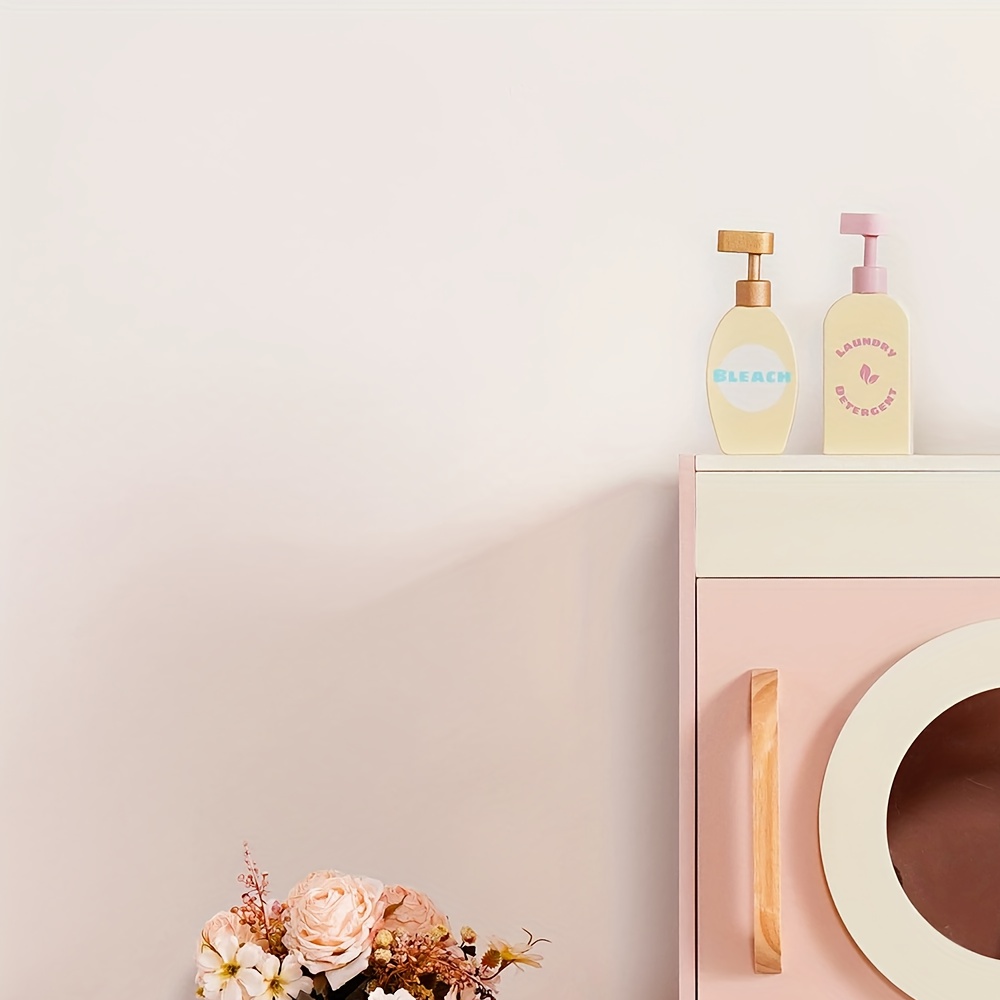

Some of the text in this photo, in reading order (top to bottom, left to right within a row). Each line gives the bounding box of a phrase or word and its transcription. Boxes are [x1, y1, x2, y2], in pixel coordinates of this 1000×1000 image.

[835, 338, 897, 358] LAUNDRY
[713, 368, 792, 383] BLEACH
[835, 385, 897, 417] DETERGENT
